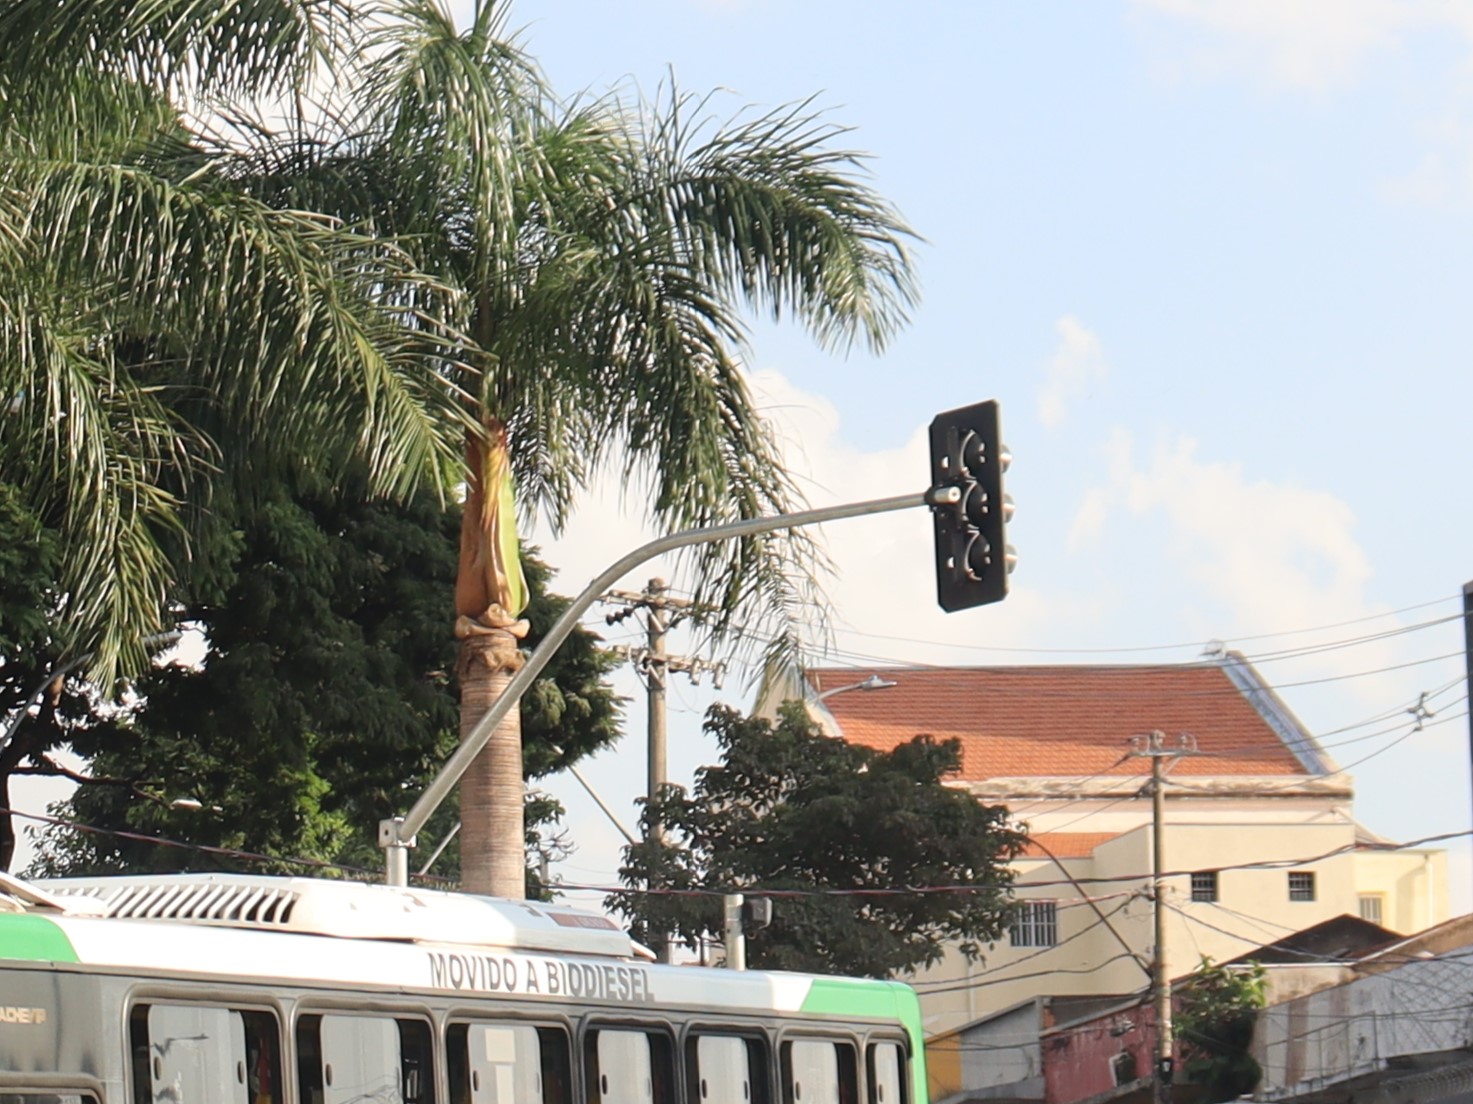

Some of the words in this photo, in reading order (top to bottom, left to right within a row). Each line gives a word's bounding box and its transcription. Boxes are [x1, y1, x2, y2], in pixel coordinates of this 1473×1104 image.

[427, 952, 517, 992] MOVIDO
[527, 959, 540, 993] A
[545, 961, 655, 1001] BIODIESEL
